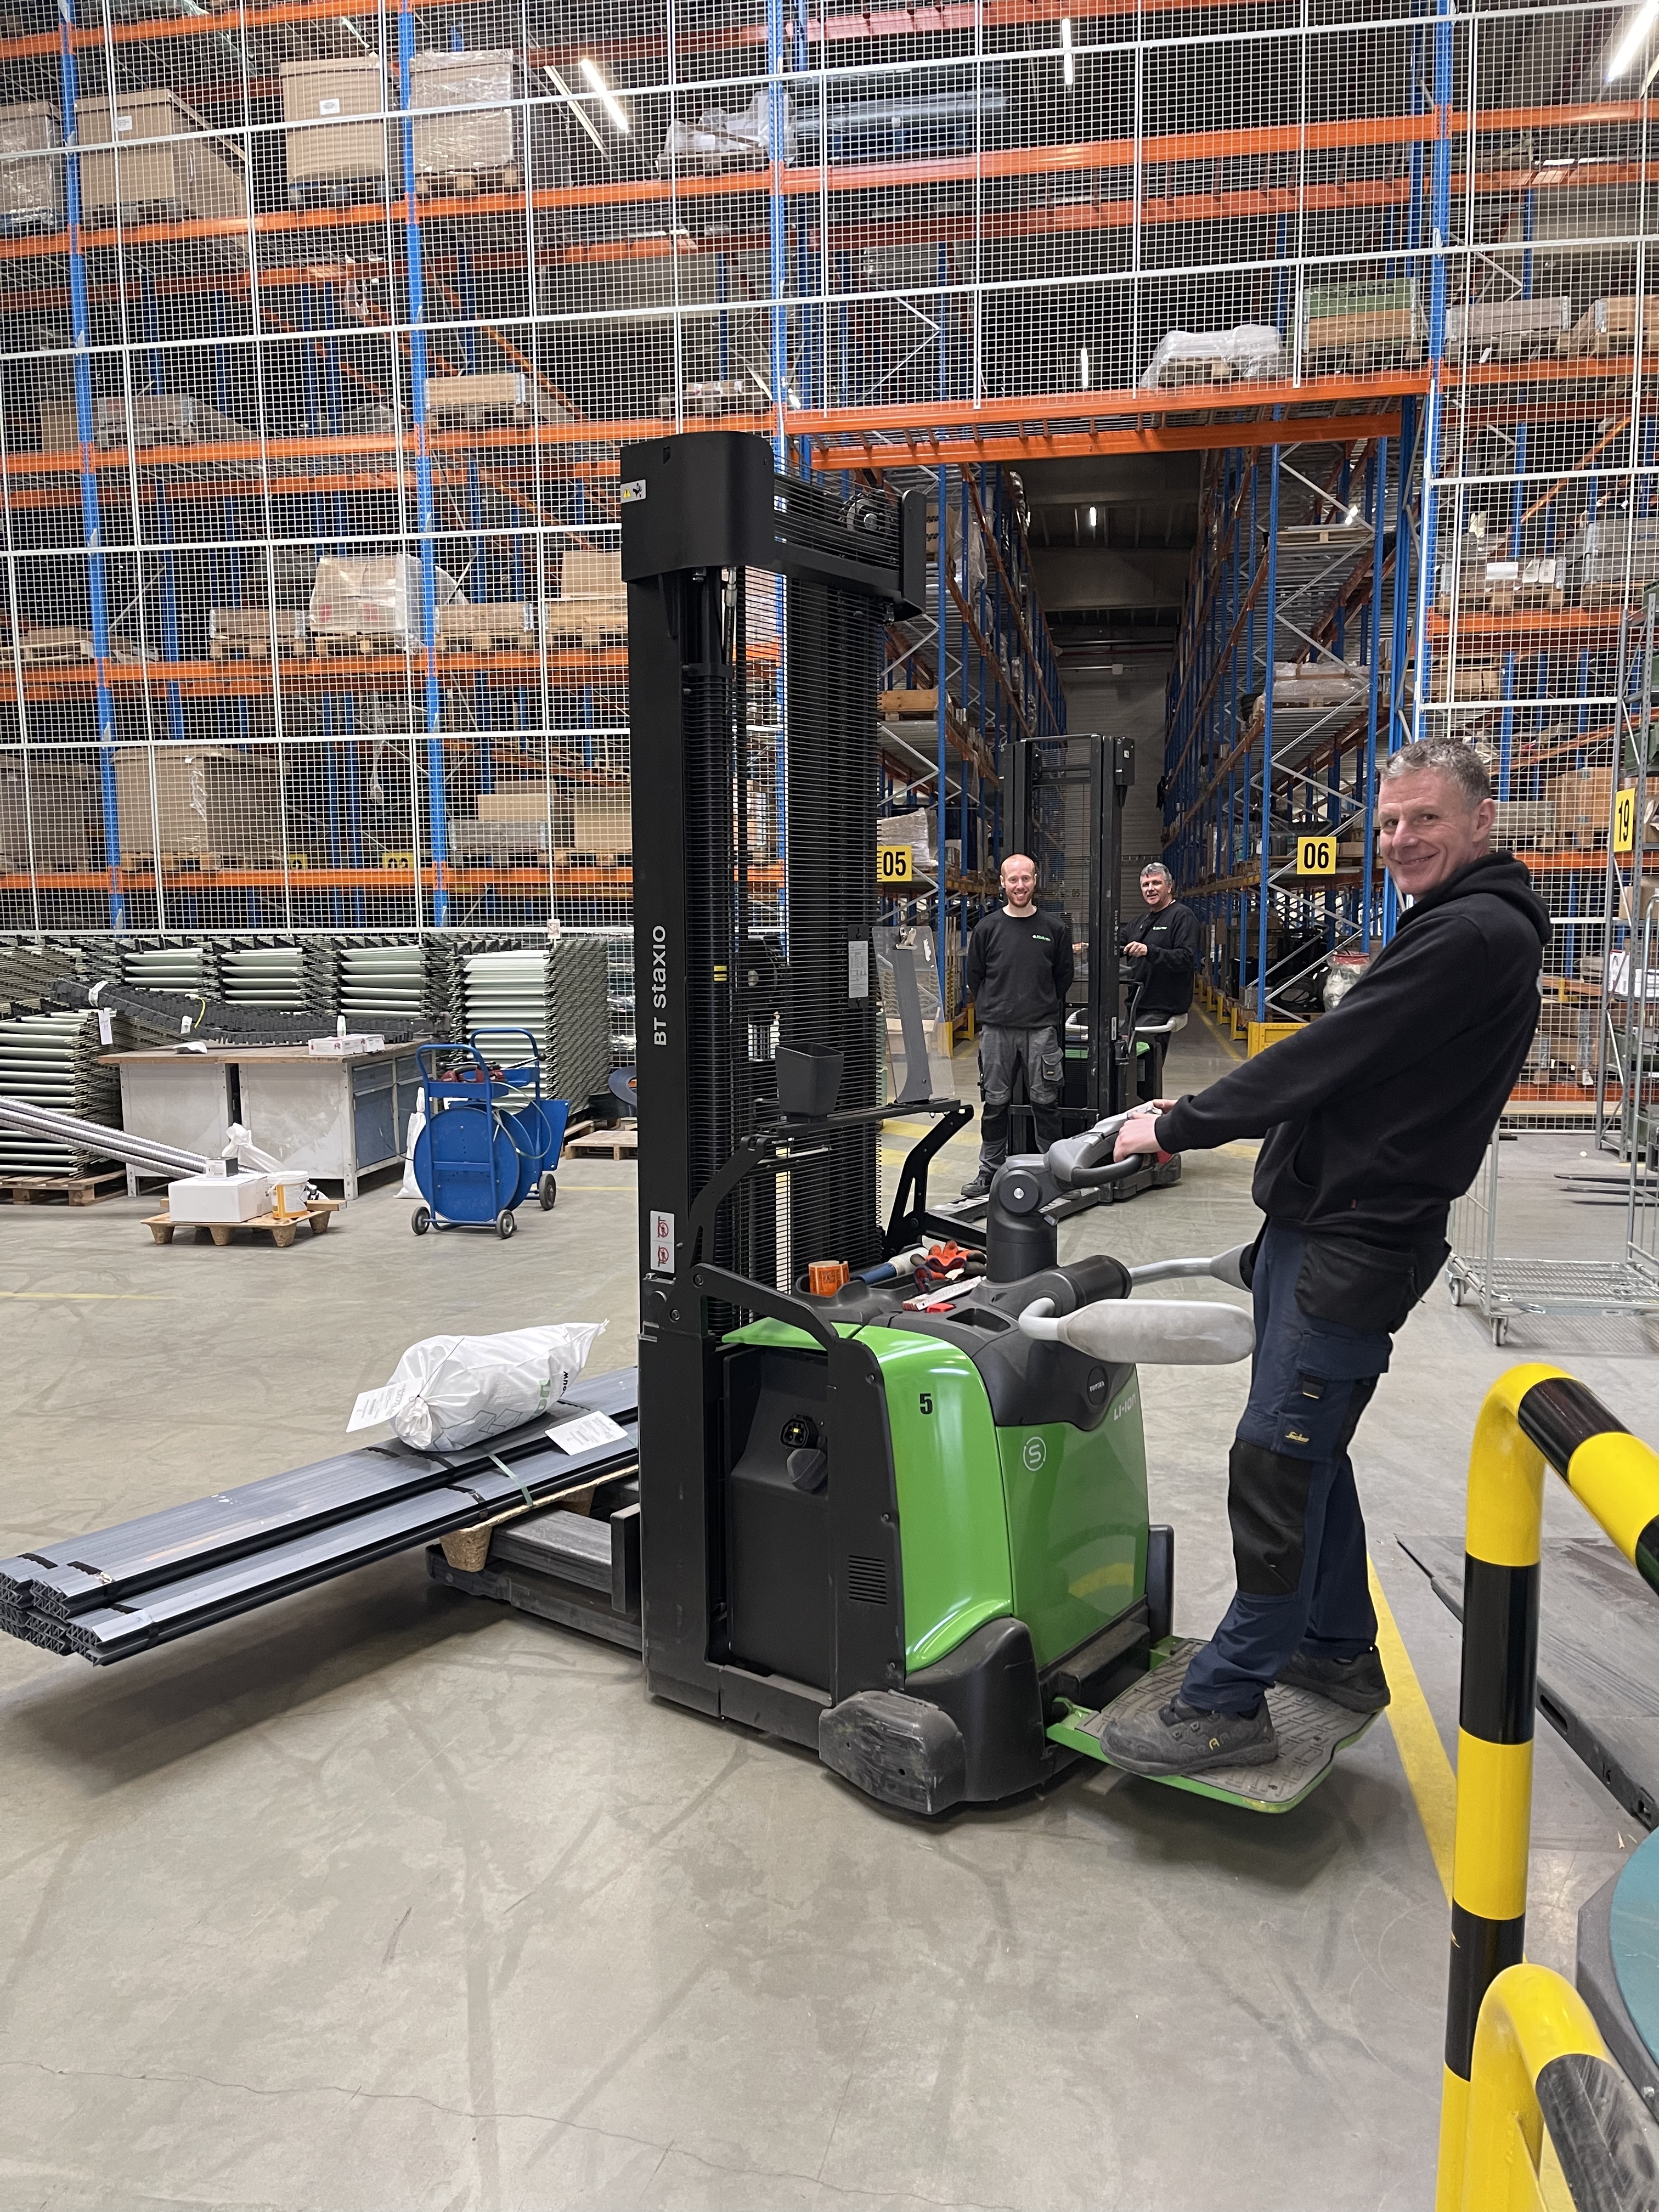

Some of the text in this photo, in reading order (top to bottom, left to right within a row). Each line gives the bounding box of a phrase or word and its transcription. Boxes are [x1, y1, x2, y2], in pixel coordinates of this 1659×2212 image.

[1618, 799, 1630, 842] 19
[883, 851, 906, 877] 05
[1304, 842, 1329, 869] 06
[653, 1017, 667, 1046] BT
[919, 1393, 933, 1415] 5
